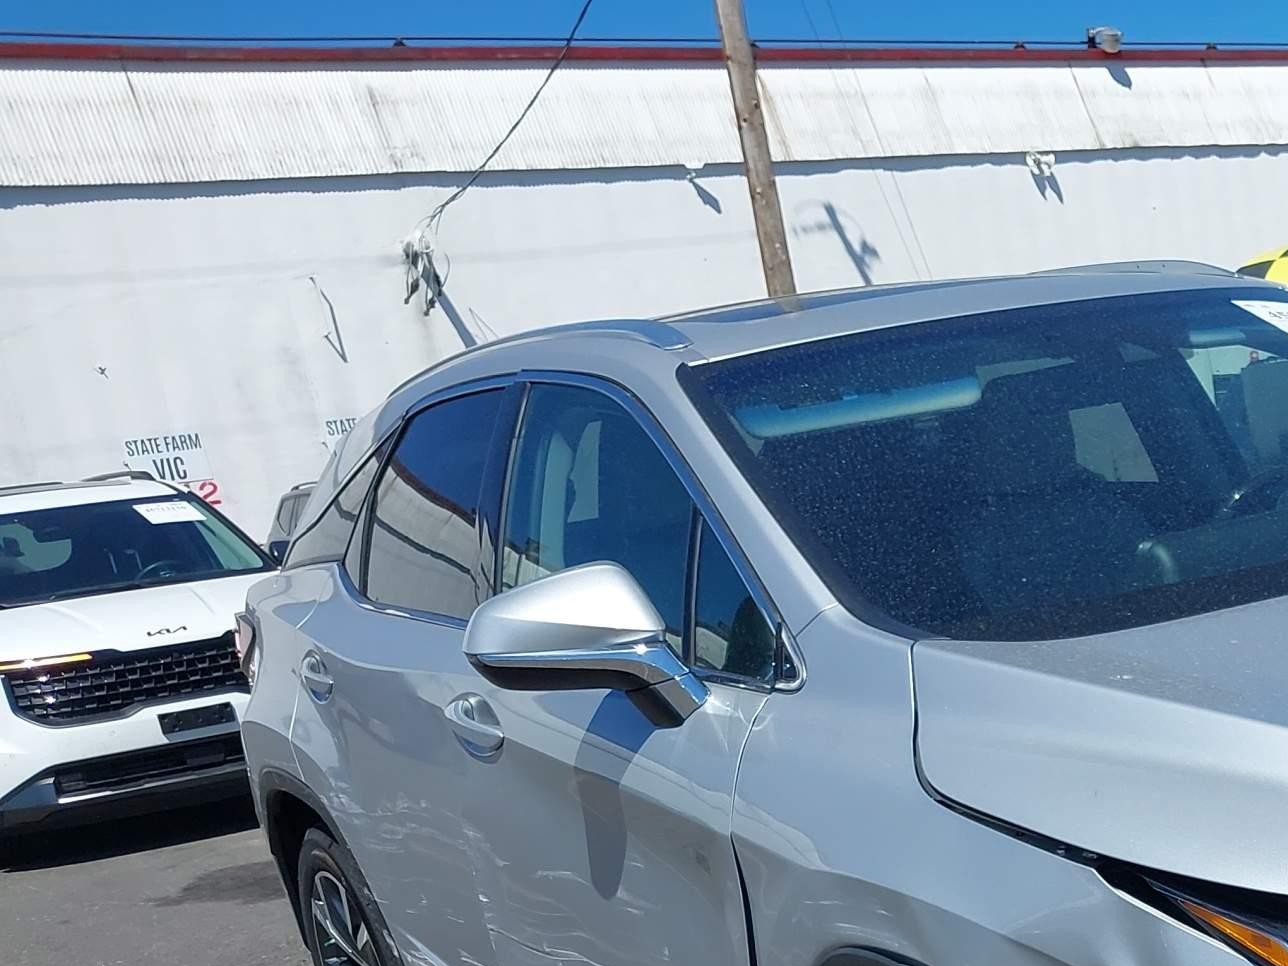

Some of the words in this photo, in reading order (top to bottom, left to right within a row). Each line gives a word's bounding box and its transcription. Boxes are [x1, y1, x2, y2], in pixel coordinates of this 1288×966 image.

[124, 437, 163, 457] STATE
[164, 432, 202, 453] FARM
[152, 456, 188, 481] VIC
[199, 481, 222, 505] 2
